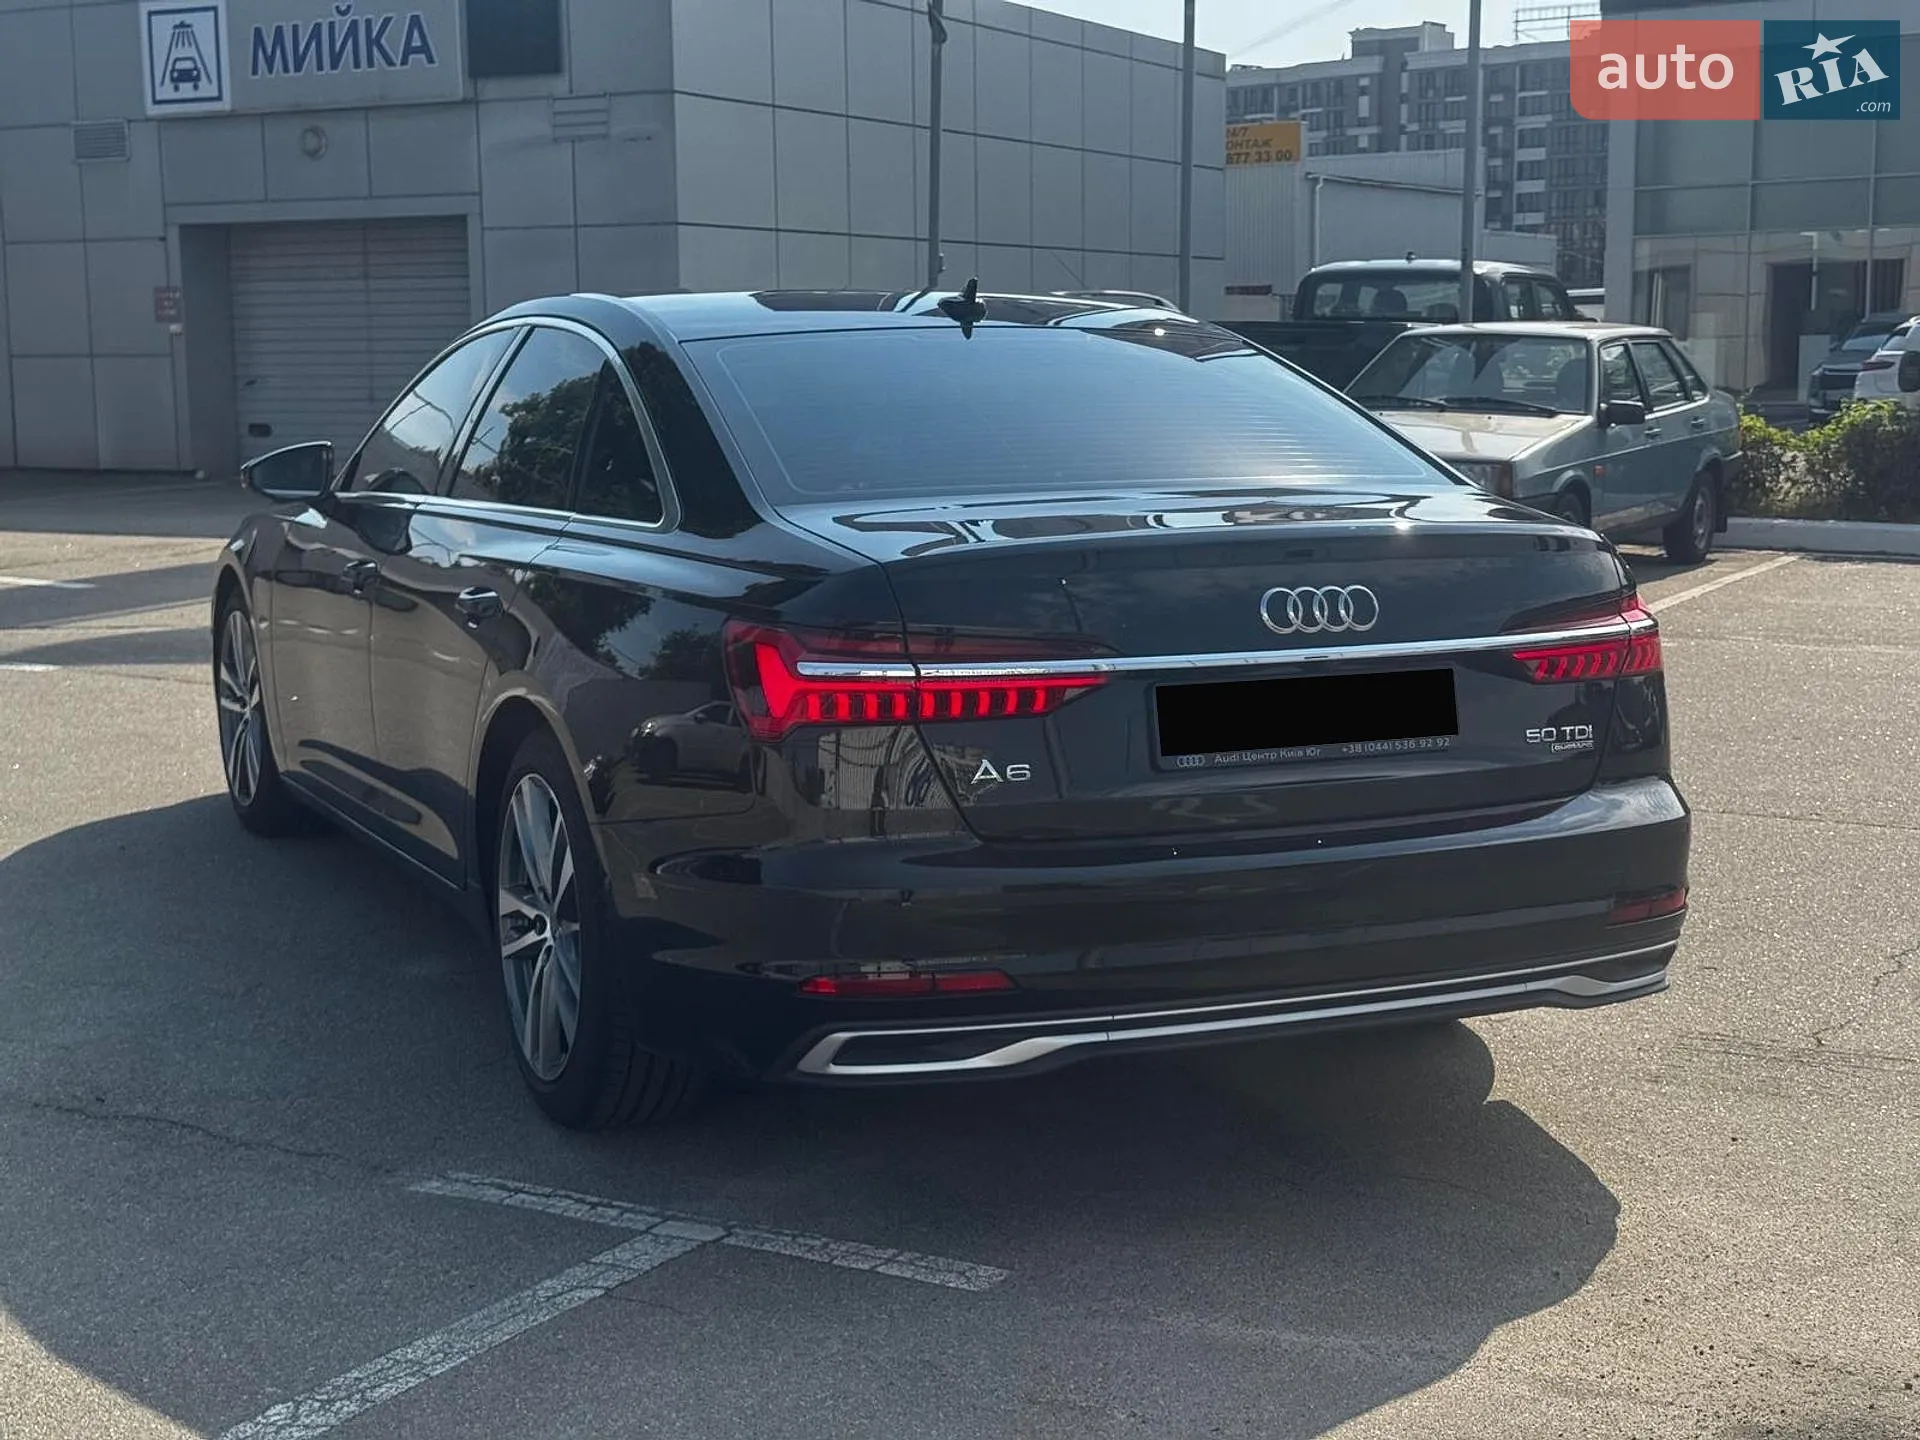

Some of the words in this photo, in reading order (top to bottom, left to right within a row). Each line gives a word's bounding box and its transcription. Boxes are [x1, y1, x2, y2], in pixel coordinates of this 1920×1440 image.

[250, 4, 437, 77] МИЙКА
[1526, 727, 1557, 743] 50
[1560, 724, 1593, 741] TDI
[1214, 753, 1240, 764] Audi
[1242, 750, 1277, 763] Центр
[970, 759, 1031, 785] A6
